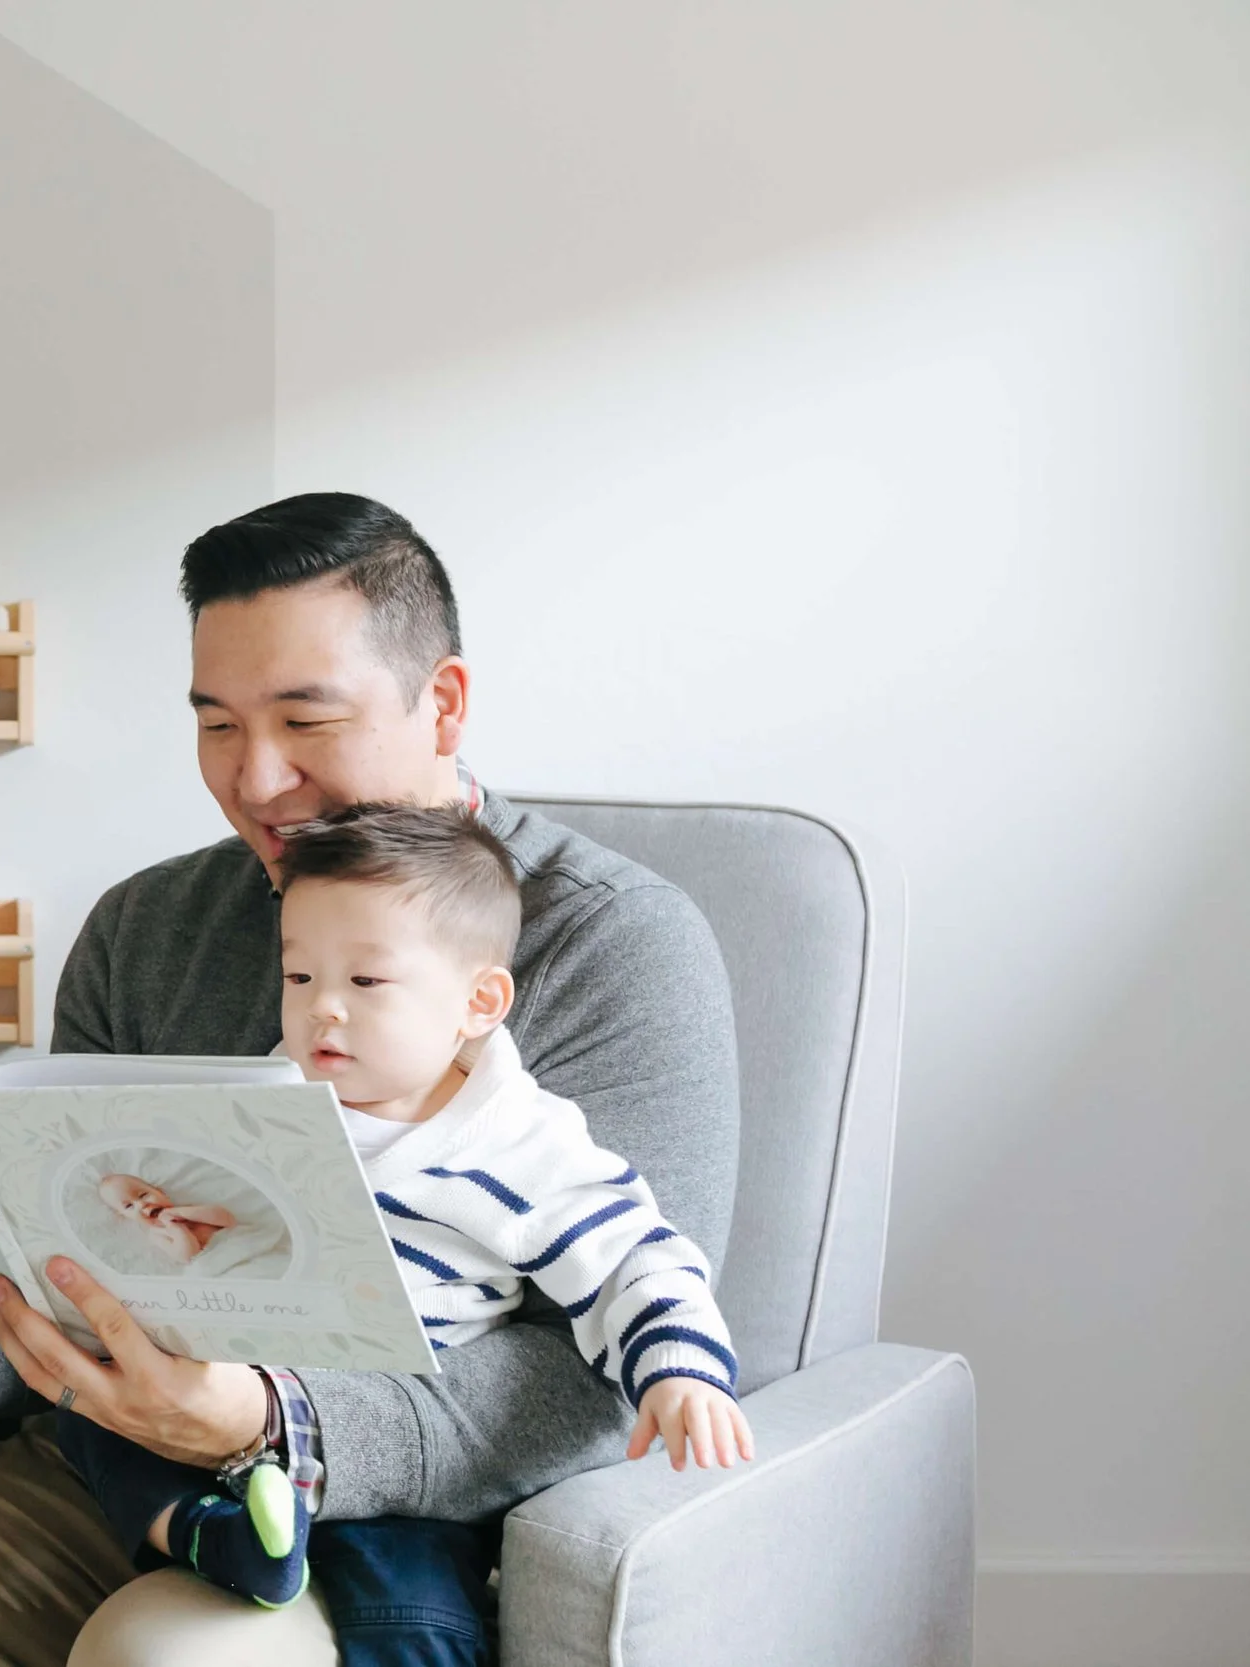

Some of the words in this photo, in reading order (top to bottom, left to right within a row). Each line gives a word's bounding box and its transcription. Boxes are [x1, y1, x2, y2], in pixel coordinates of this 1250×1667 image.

[119, 1299, 168, 1310] our
[176, 1288, 254, 1313] little
[263, 1304, 310, 1316] one
